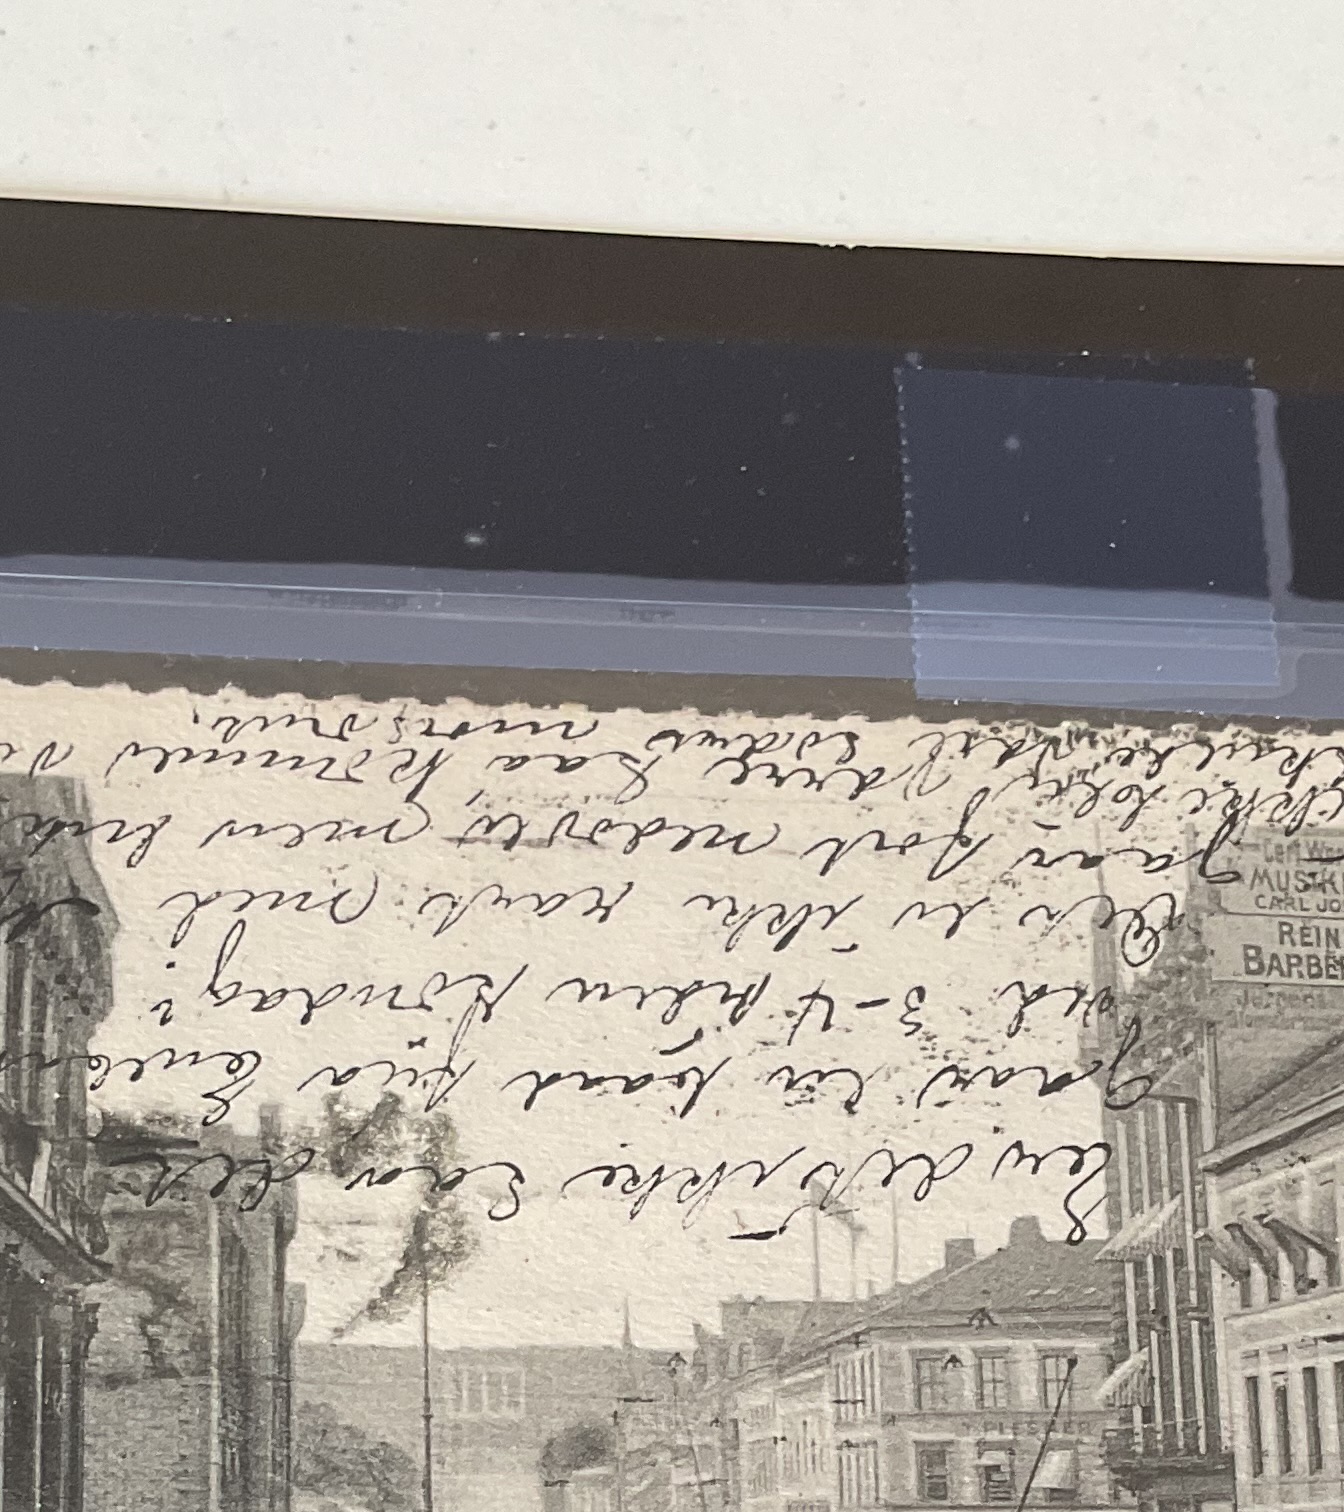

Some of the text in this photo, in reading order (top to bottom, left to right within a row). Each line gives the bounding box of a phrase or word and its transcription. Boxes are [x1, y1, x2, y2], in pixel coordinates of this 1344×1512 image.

[682, 894, 860, 952] ikke
[1253, 895, 1312, 912] CARL
[786, 983, 926, 1045] 3-4
